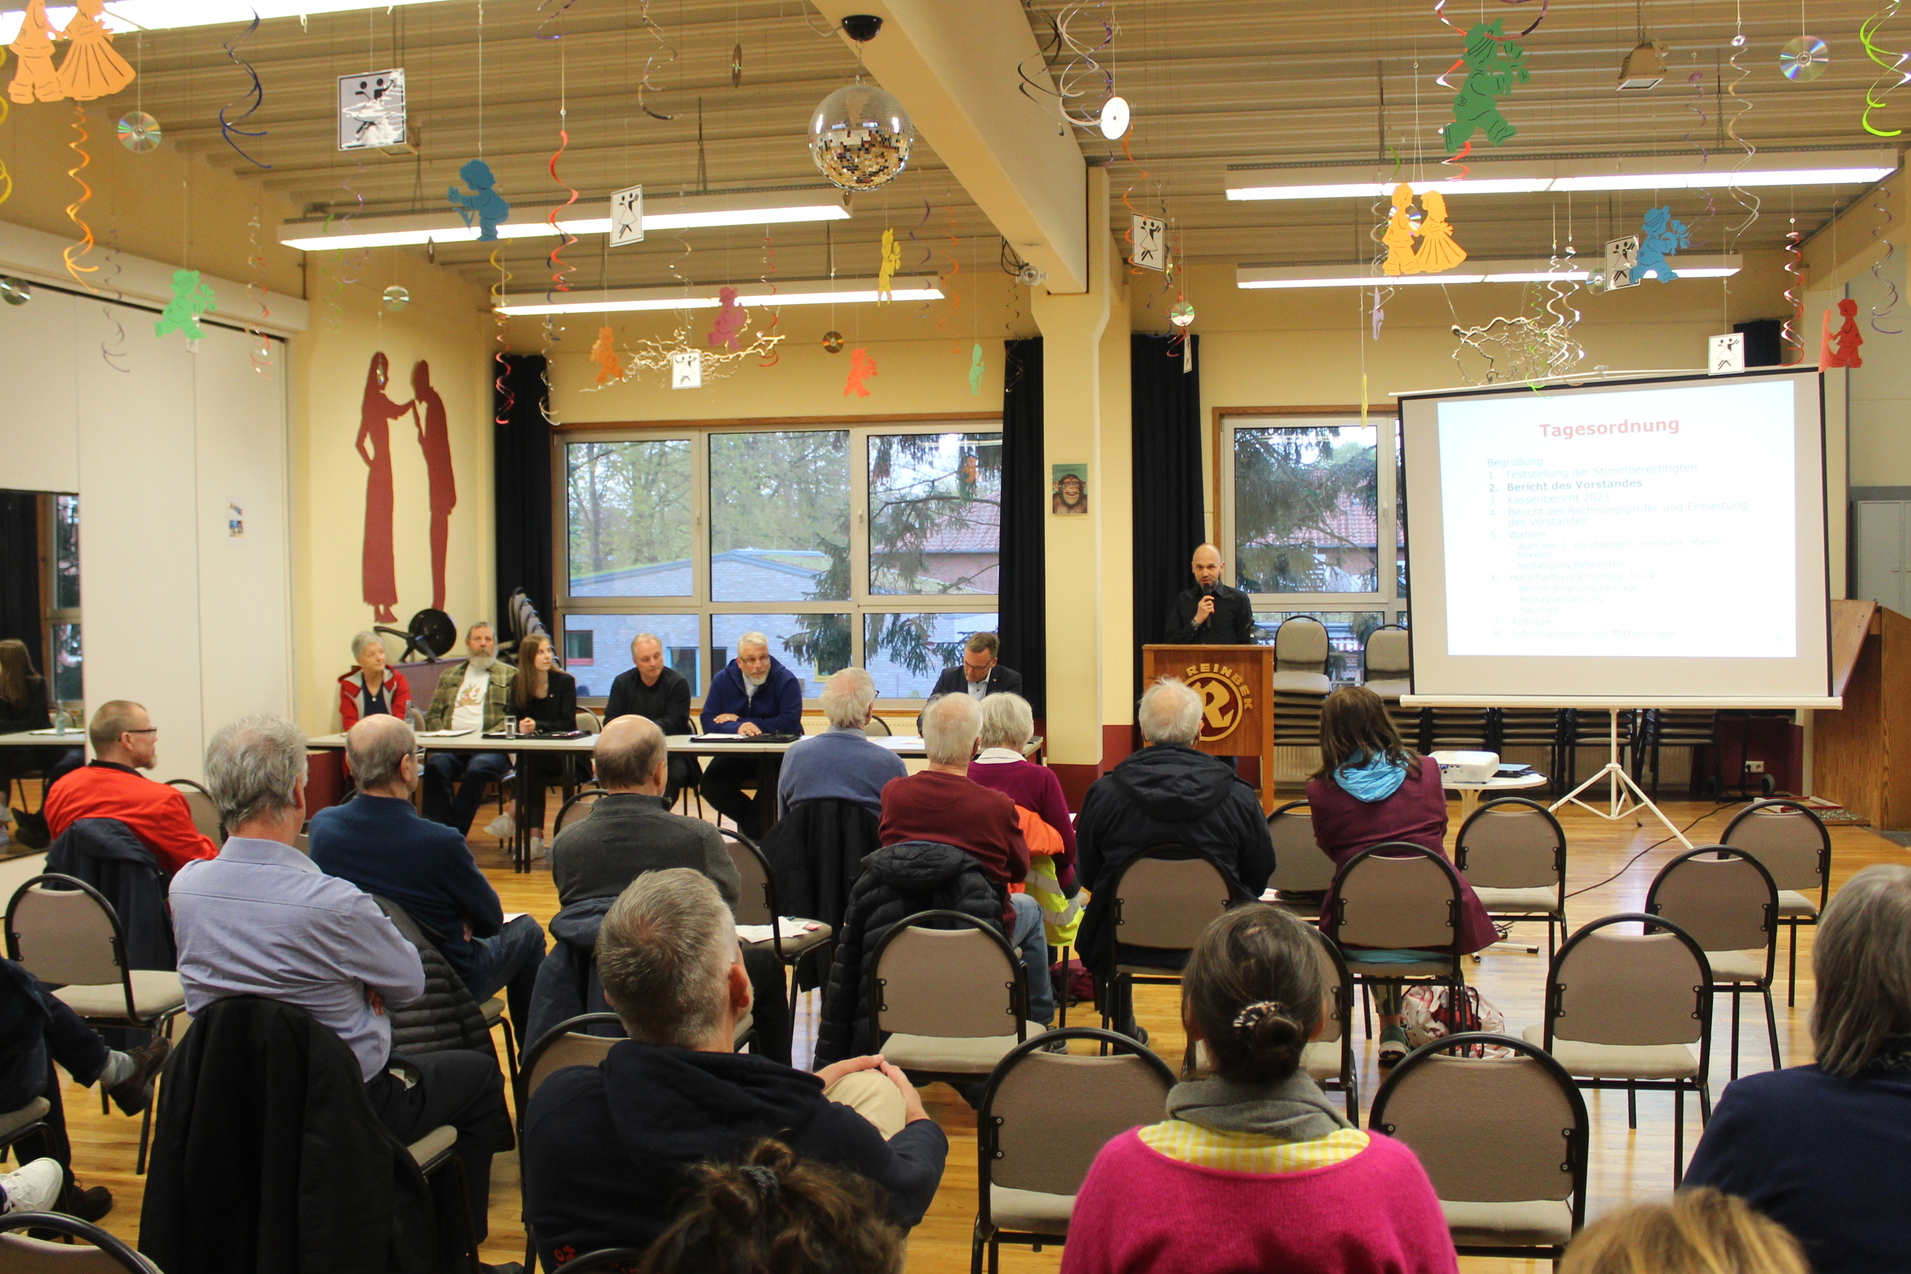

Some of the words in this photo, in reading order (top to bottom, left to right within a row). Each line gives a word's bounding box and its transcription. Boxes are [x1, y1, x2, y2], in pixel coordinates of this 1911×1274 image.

[1540, 418, 1680, 440] Tagesordnung
[1487, 457, 1543, 468] Begrüßung
[1488, 484, 1499, 492] 2.
[1507, 482, 1547, 492] Bericht
[1551, 481, 1572, 490] des
[1576, 479, 1643, 489] Vorstandes
[1186, 663, 1253, 710] REINBEK
